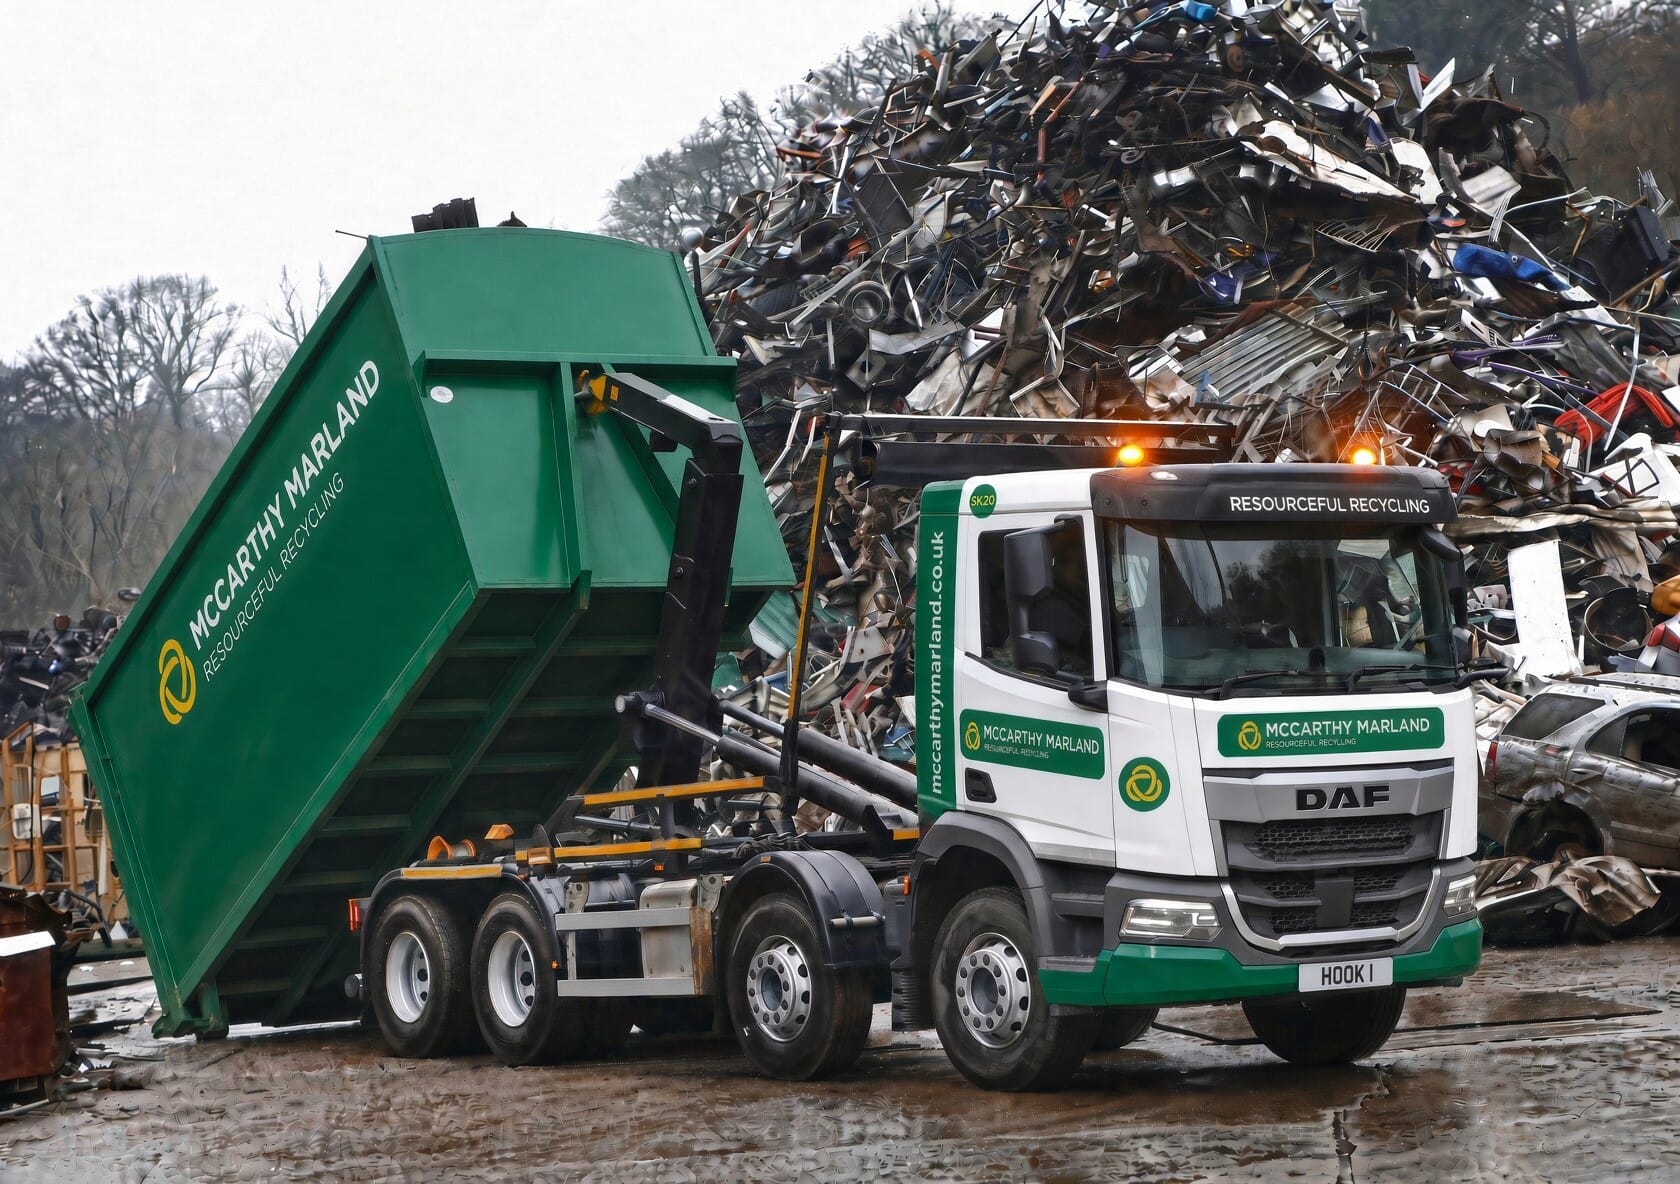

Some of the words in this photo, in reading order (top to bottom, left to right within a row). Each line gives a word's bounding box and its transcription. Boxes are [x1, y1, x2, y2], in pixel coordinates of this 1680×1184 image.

[188, 492, 285, 651] MCCARTHY
[283, 360, 381, 510] MARLAND
[971, 495, 995, 507] SK20
[1230, 496, 1347, 512] RESOURCEFUL
[1350, 497, 1430, 513] RECYCLING
[202, 565, 282, 682] RESOURCEFUL
[279, 472, 345, 570] RECYCLING
[929, 531, 944, 795] mccarthymarland.co.uk
[983, 725, 1043, 747] MCCARTHY
[1046, 734, 1100, 754] MARLAND
[1265, 720, 1352, 737] MCCARTHY
[1357, 718, 1430, 734] MARLAND
[1295, 785, 1390, 811] DAF
